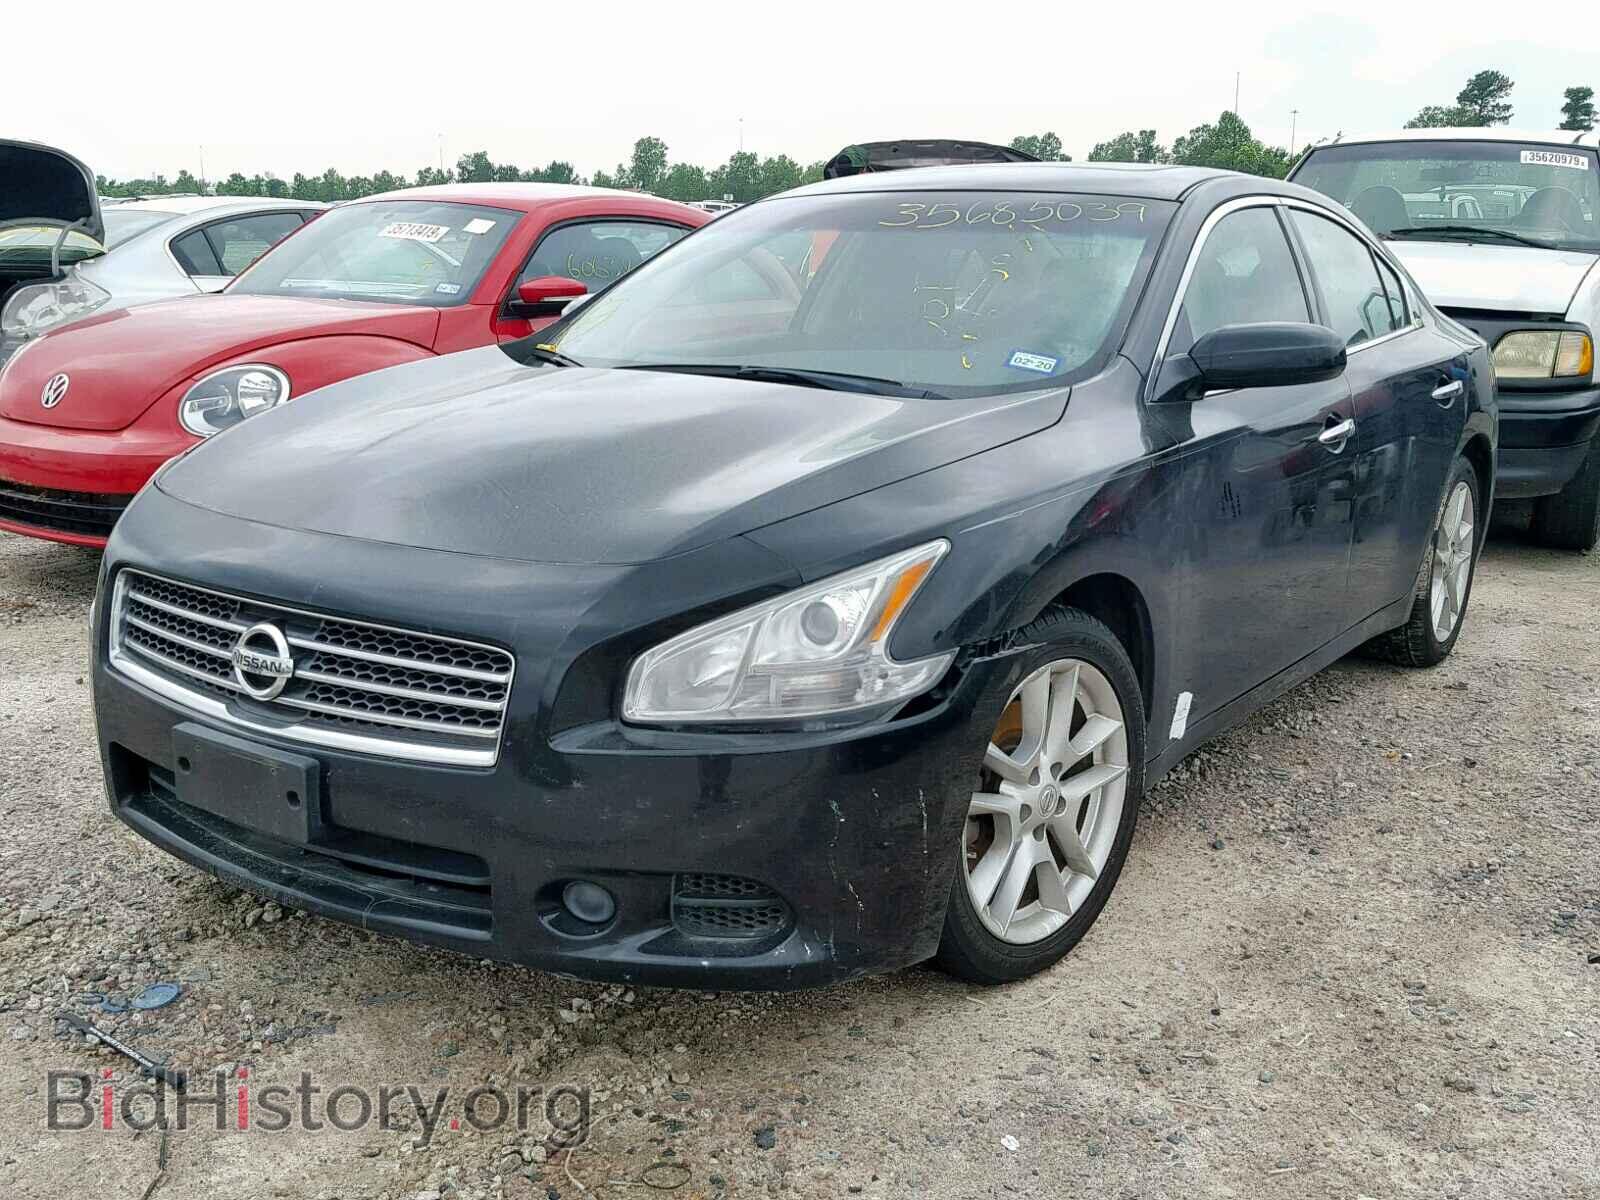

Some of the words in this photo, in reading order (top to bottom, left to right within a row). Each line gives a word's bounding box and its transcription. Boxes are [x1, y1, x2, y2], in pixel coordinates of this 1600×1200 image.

[1528, 151, 1581, 167] 35620979
[877, 200, 1148, 229] 35685039
[1014, 356, 1053, 370] 02-20
[234, 650, 282, 673] NISSAN
